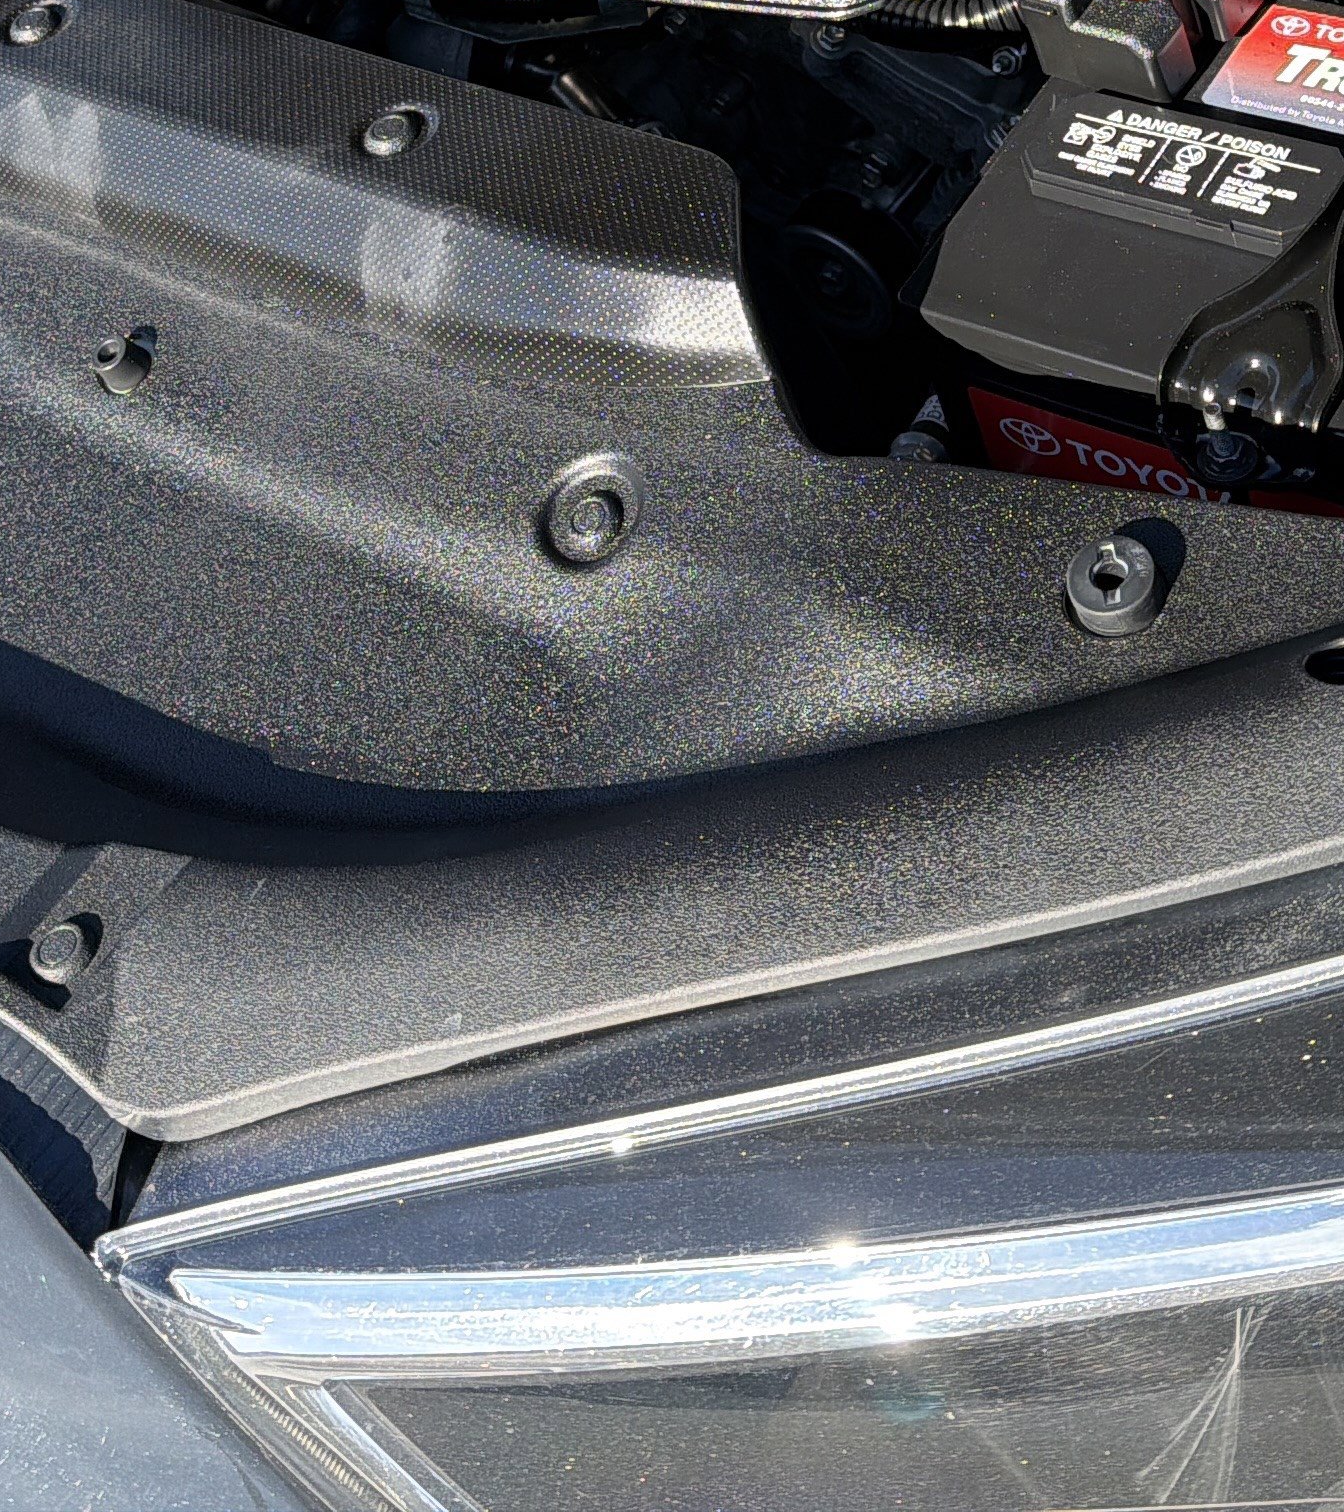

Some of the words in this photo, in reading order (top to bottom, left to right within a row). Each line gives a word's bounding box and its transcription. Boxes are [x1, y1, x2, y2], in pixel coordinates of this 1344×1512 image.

[1230, 95, 1288, 114] Distributed
[1287, 106, 1301, 118] by
[1302, 109, 1336, 125] Toyota
[1126, 113, 1203, 141] DANGER
[1218, 133, 1291, 161] POISON
